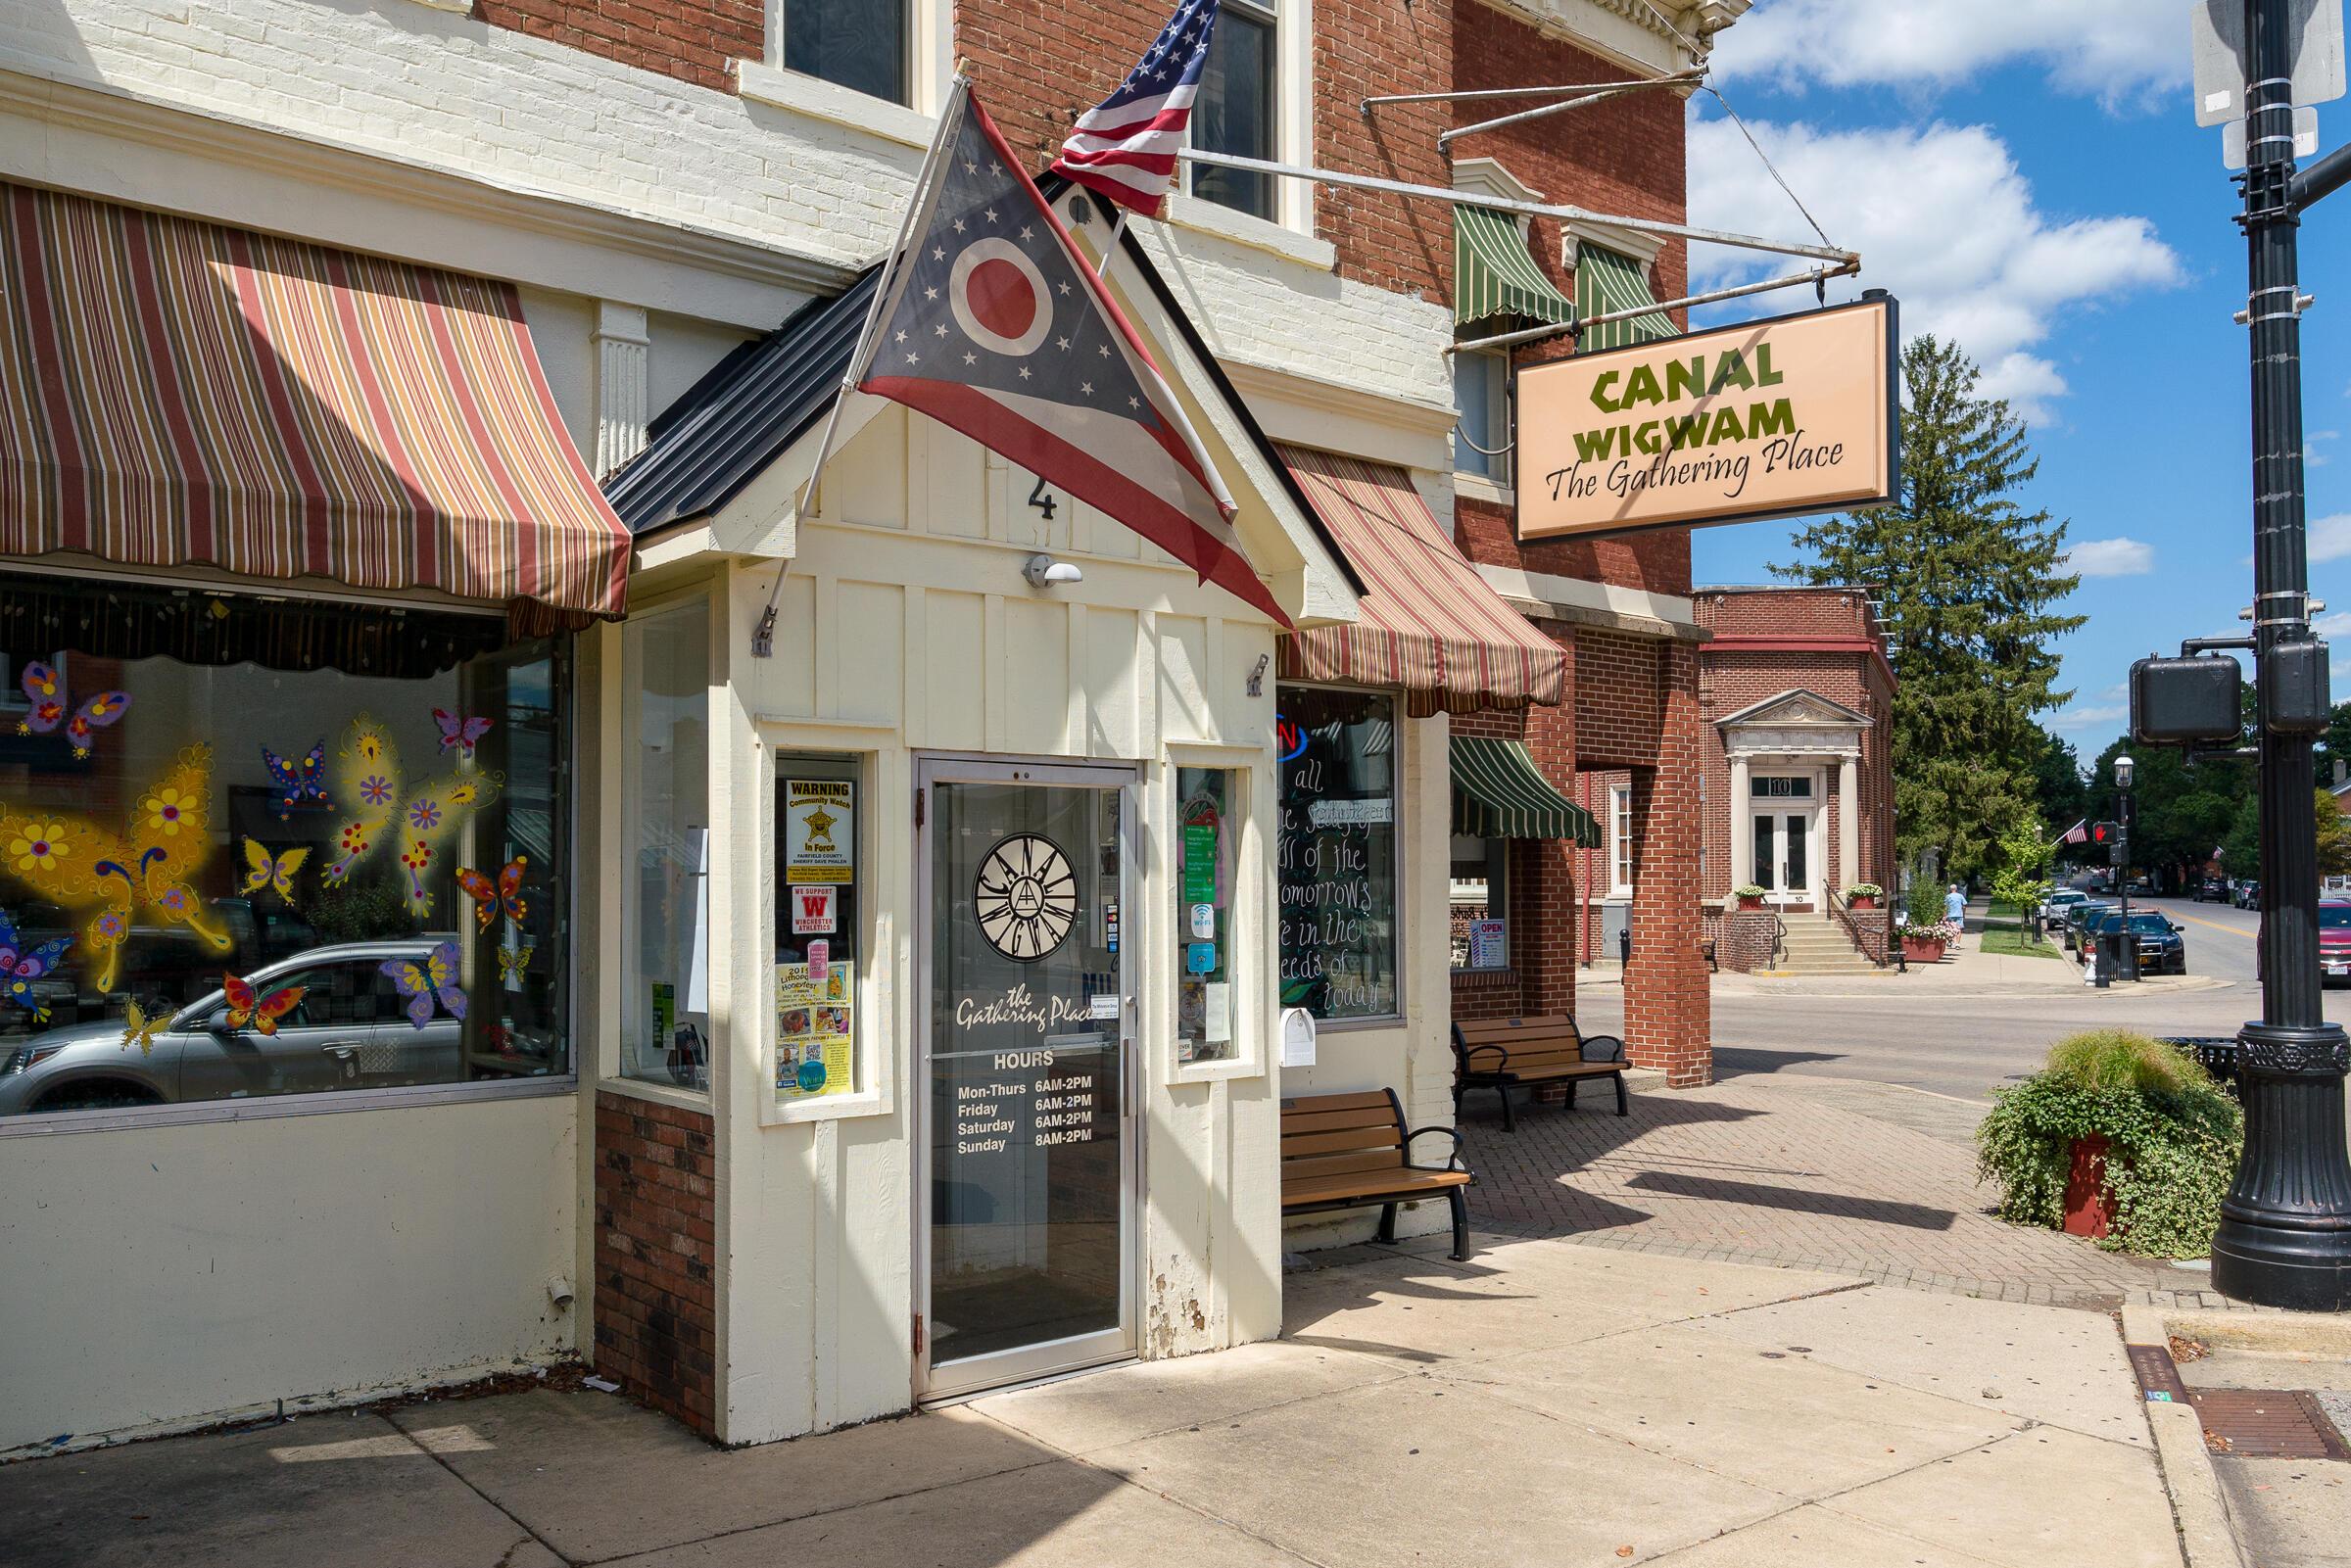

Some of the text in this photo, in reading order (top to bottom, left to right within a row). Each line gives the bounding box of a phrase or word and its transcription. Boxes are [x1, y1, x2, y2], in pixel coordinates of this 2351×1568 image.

[1589, 342, 1785, 414] CANAL
[1572, 398, 1797, 464] WIGWAM
[1546, 429, 1844, 501] The Gathering Place
[1295, 759, 1324, 791] all
[1772, 778, 1791, 795] 10
[792, 783, 849, 796] WARNING
[790, 796, 851, 810] Community Watch
[804, 842, 836, 852] In Force
[1304, 836, 1324, 876] of
[1333, 839, 1367, 875] the
[801, 895, 829, 918] W
[1277, 876, 1371, 911] omorrows
[1299, 915, 1319, 946] in
[1322, 910, 1362, 945] the
[1481, 924, 1503, 932] OPEN
[1280, 948, 1349, 983] eeds of
[781, 974, 809, 984] Lithopo
[1006, 982, 1032, 1008] the
[1323, 979, 1379, 1012] today
[956, 997, 1046, 1033] Gathering
[1050, 995, 1092, 1028] Place
[994, 1050, 1054, 1070] HOURS
[958, 1075, 1092, 1100] Mon-Thurs 6AM-2PM
[958, 1093, 1092, 1118] Friday 6AM-2PM
[958, 1111, 1092, 1136] Saturday 6AM-2PM
[958, 1128, 1092, 1155] Sunday 8AM-2PM
